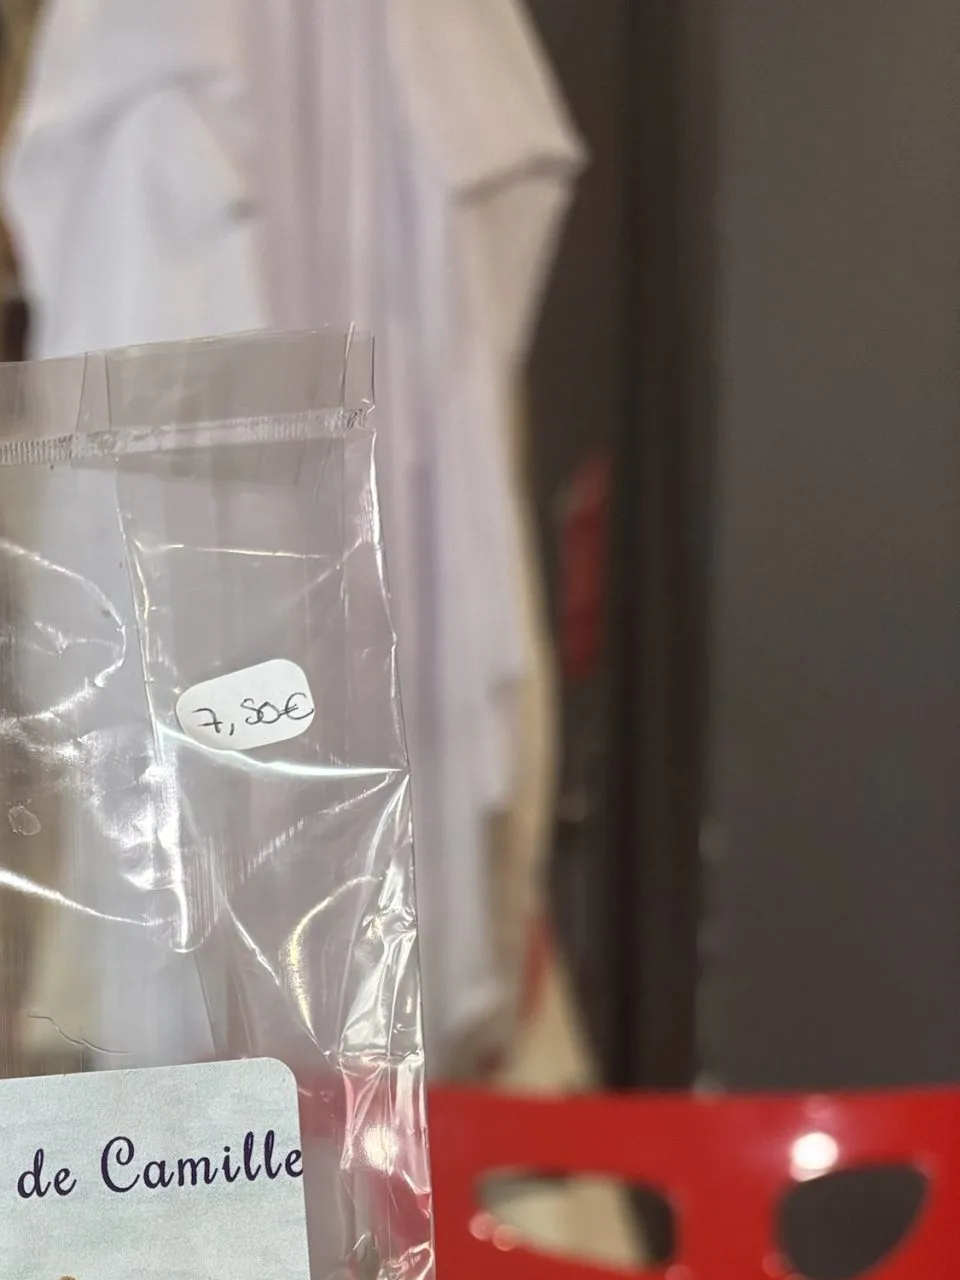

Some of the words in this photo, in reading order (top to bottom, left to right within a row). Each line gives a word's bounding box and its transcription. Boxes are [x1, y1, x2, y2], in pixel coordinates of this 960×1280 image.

[191, 692, 315, 736] 7,50€
[16, 1148, 78, 1200] de
[100, 1129, 304, 1194] Camille
